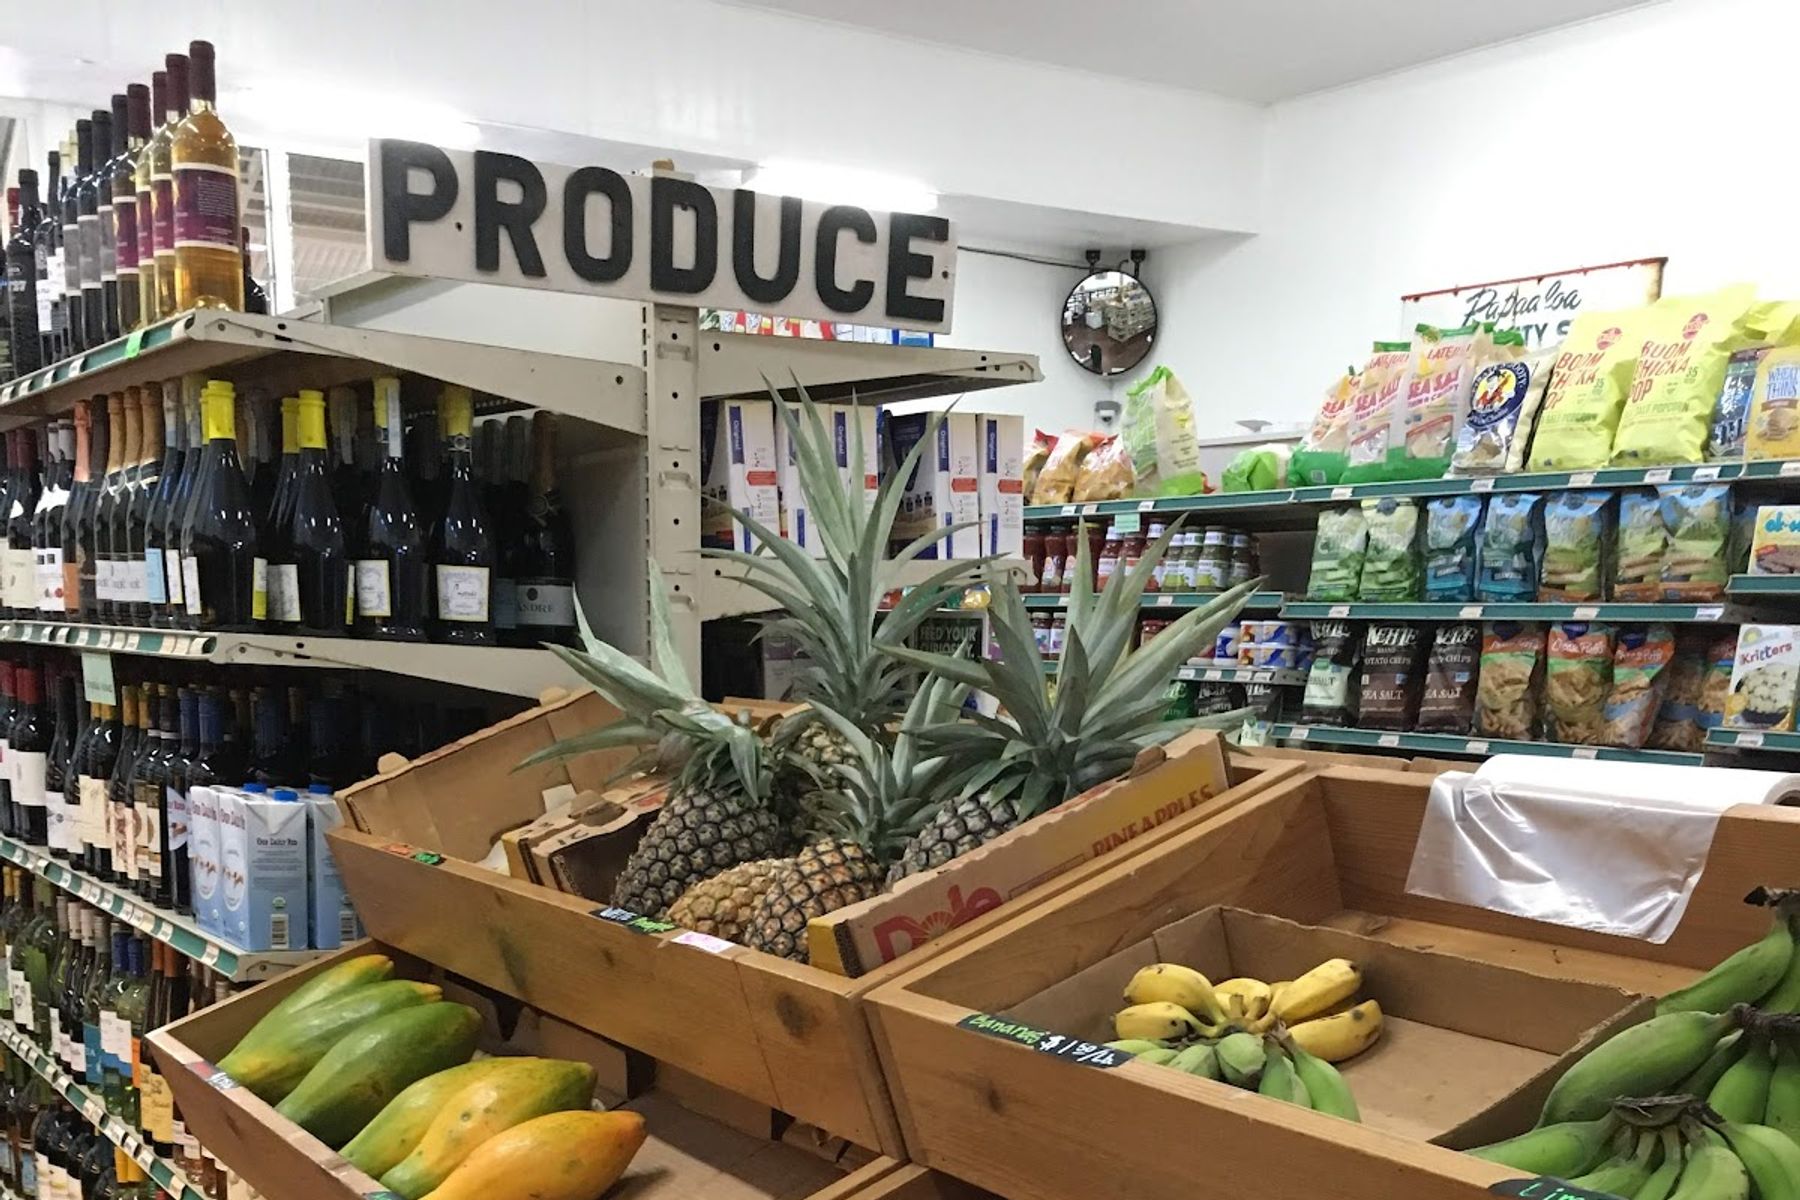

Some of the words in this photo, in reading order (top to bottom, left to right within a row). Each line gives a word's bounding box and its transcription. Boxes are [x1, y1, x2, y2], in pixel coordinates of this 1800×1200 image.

[380, 139, 950, 323] PRODUCE
[837, 424, 845, 455] Original
[988, 432, 996, 462] Original
[946, 624, 977, 641] YOUR
[1740, 641, 1793, 666] Kritters
[1379, 689, 1404, 700] SALT
[1092, 783, 1215, 859] PINEAPPLES
[873, 884, 1005, 965] Dole
